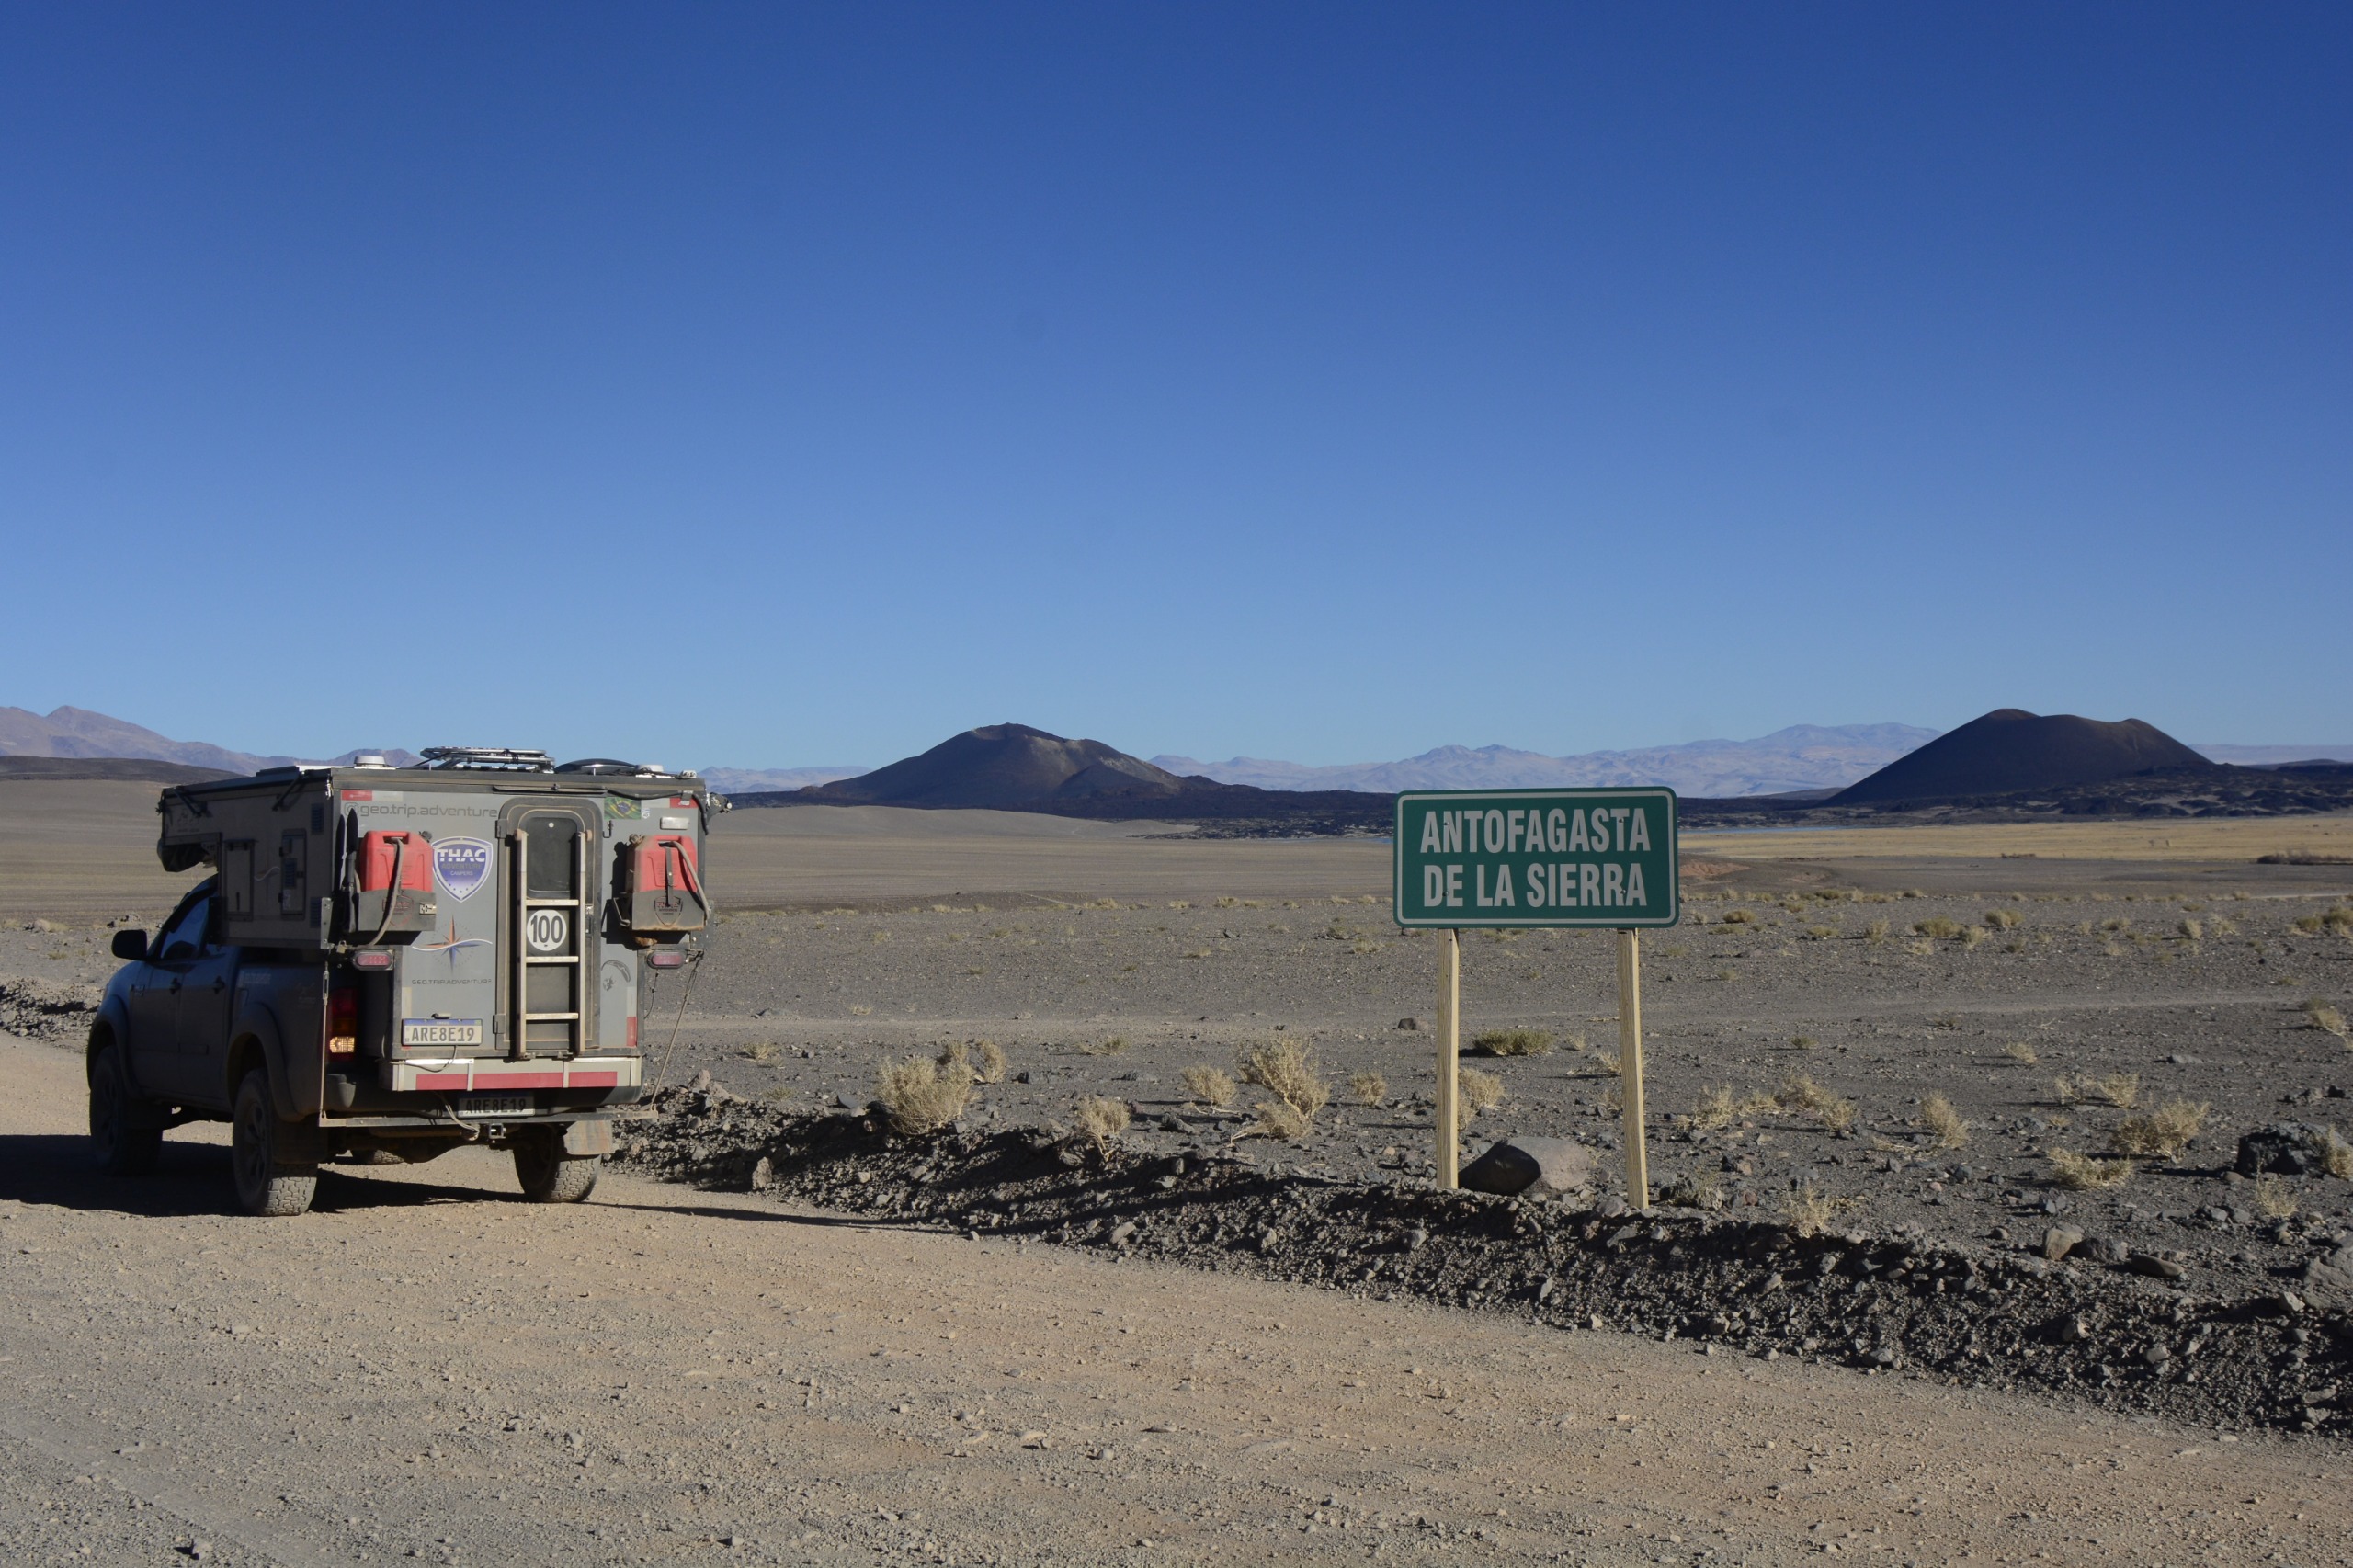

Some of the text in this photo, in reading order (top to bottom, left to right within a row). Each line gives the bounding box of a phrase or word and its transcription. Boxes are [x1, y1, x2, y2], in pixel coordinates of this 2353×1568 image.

[360, 803, 498, 817] geo.trip.adventure
[1420, 807, 1651, 853] ANTOFAGASTA
[437, 848, 485, 862] THAC
[1424, 862, 1648, 907] DE LA SIERRA
[530, 915, 563, 943] 100
[411, 1027, 474, 1041] ARE8E19
[465, 1098, 526, 1113] ARE8E19
